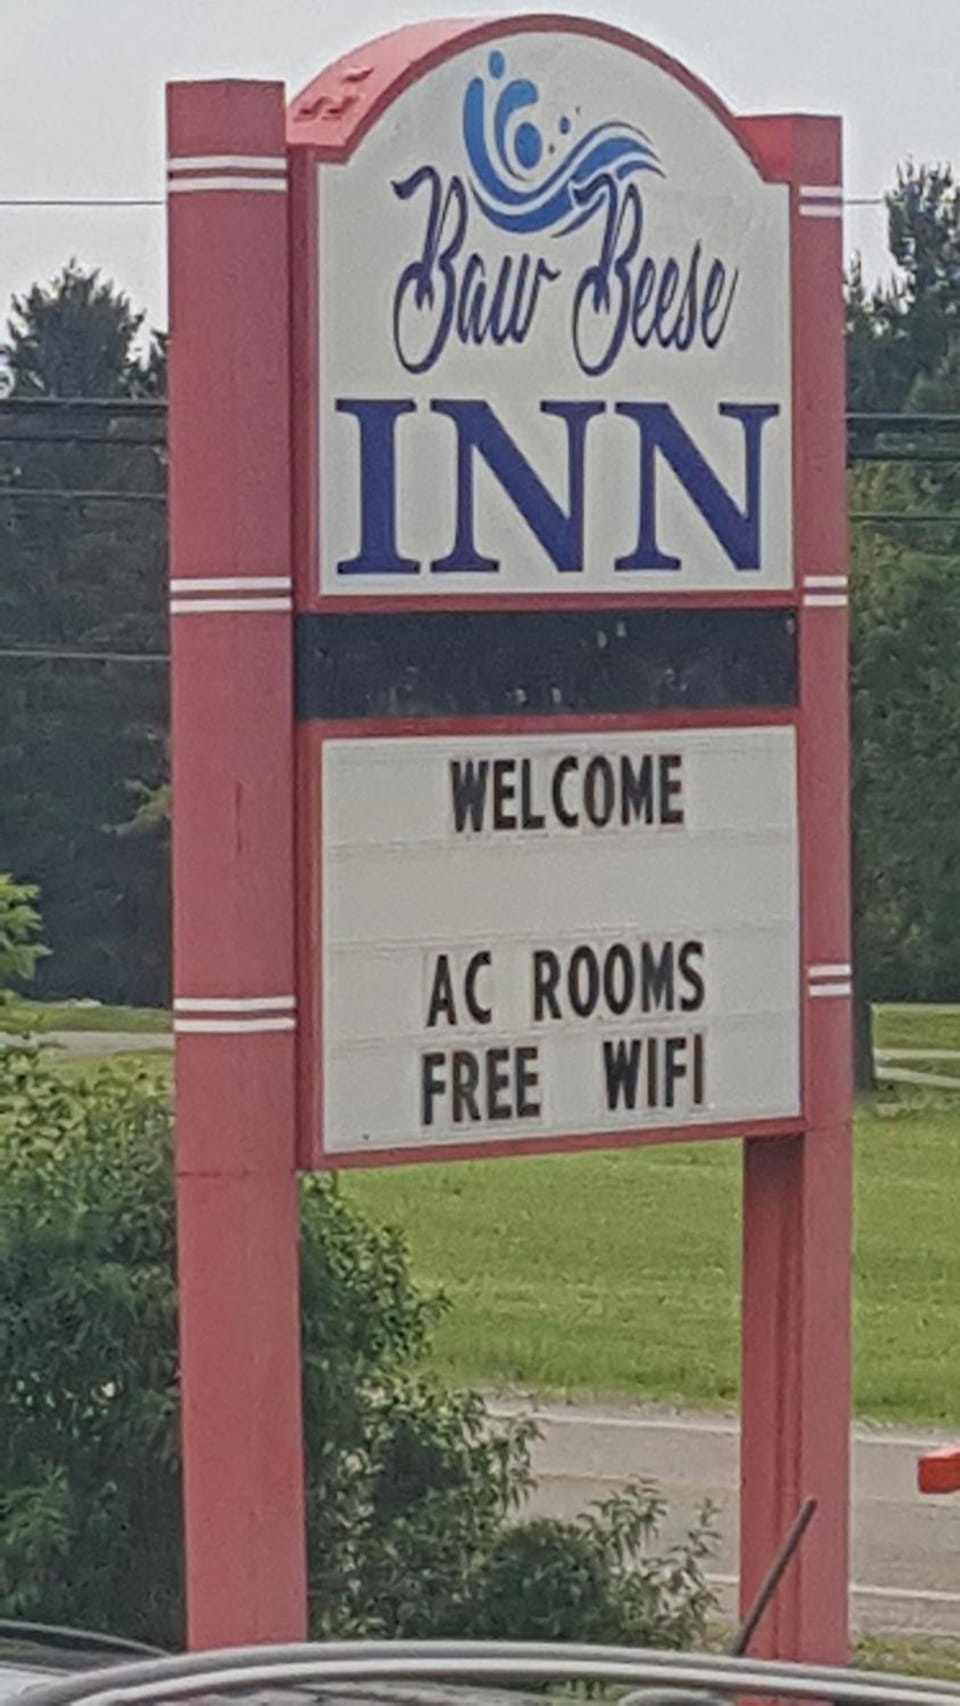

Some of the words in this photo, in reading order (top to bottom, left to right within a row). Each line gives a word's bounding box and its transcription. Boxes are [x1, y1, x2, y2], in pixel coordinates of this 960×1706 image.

[391, 165, 561, 375] Baw
[571, 172, 739, 377] Beese
[335, 397, 781, 575] INN
[449, 754, 685, 833] WELCOME
[425, 950, 493, 1028] AC
[532, 940, 705, 1023] ROOMS
[420, 1045, 541, 1127] FREE
[602, 1033, 704, 1112] WIFI
